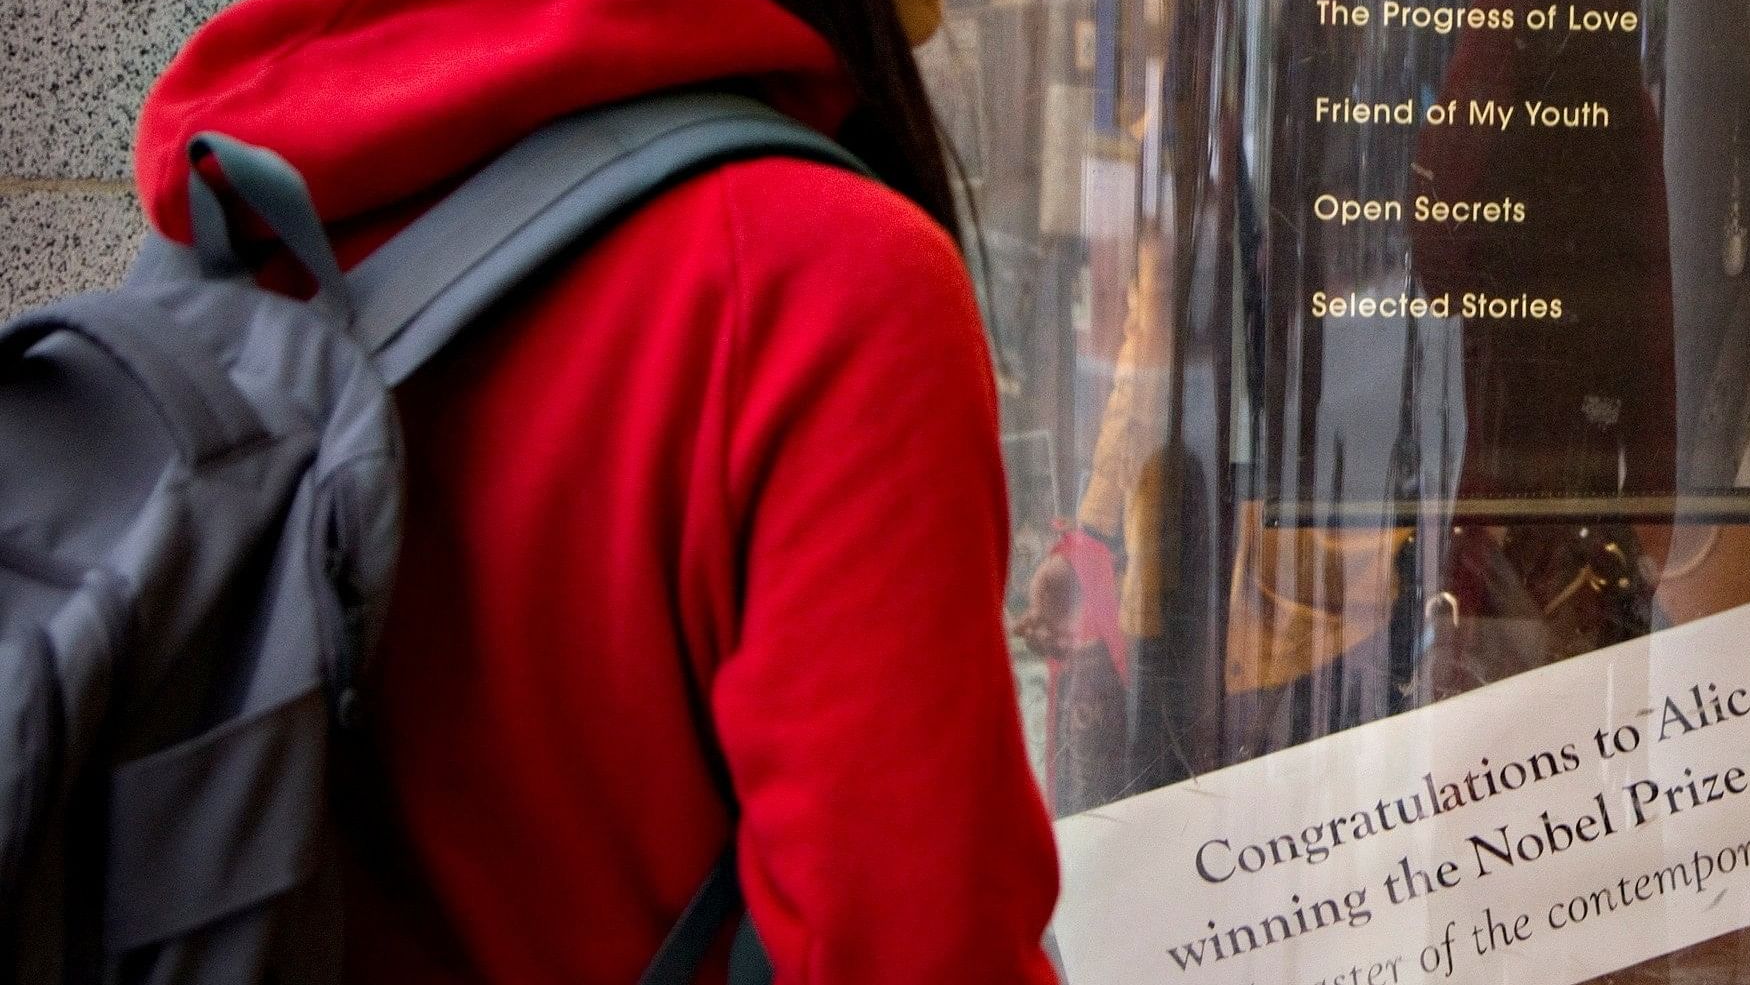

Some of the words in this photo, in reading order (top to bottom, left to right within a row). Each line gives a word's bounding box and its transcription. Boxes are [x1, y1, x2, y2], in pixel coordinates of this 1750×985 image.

[1317, 0, 1370, 26] The
[1383, 2, 1515, 35] Progress
[1527, 5, 1557, 30] of
[1568, 5, 1638, 32] Love
[1315, 96, 1413, 124] Friend
[1426, 99, 1457, 125] of
[1470, 100, 1515, 131] My
[1525, 101, 1609, 128] Youth
[1314, 194, 1401, 226] Open
[1414, 196, 1526, 223] Secrets
[1311, 292, 1449, 319] Selected
[1461, 293, 1563, 319] Stories
[1194, 742, 1581, 885] Congratulations
[1594, 725, 1640, 759] to
[1167, 886, 1372, 972] winning
[1384, 856, 1461, 905] the
[1466, 792, 1617, 879] Nobel
[1622, 766, 1748, 827] Prize
[1420, 921, 1455, 977] of
[1472, 908, 1533, 955] the
